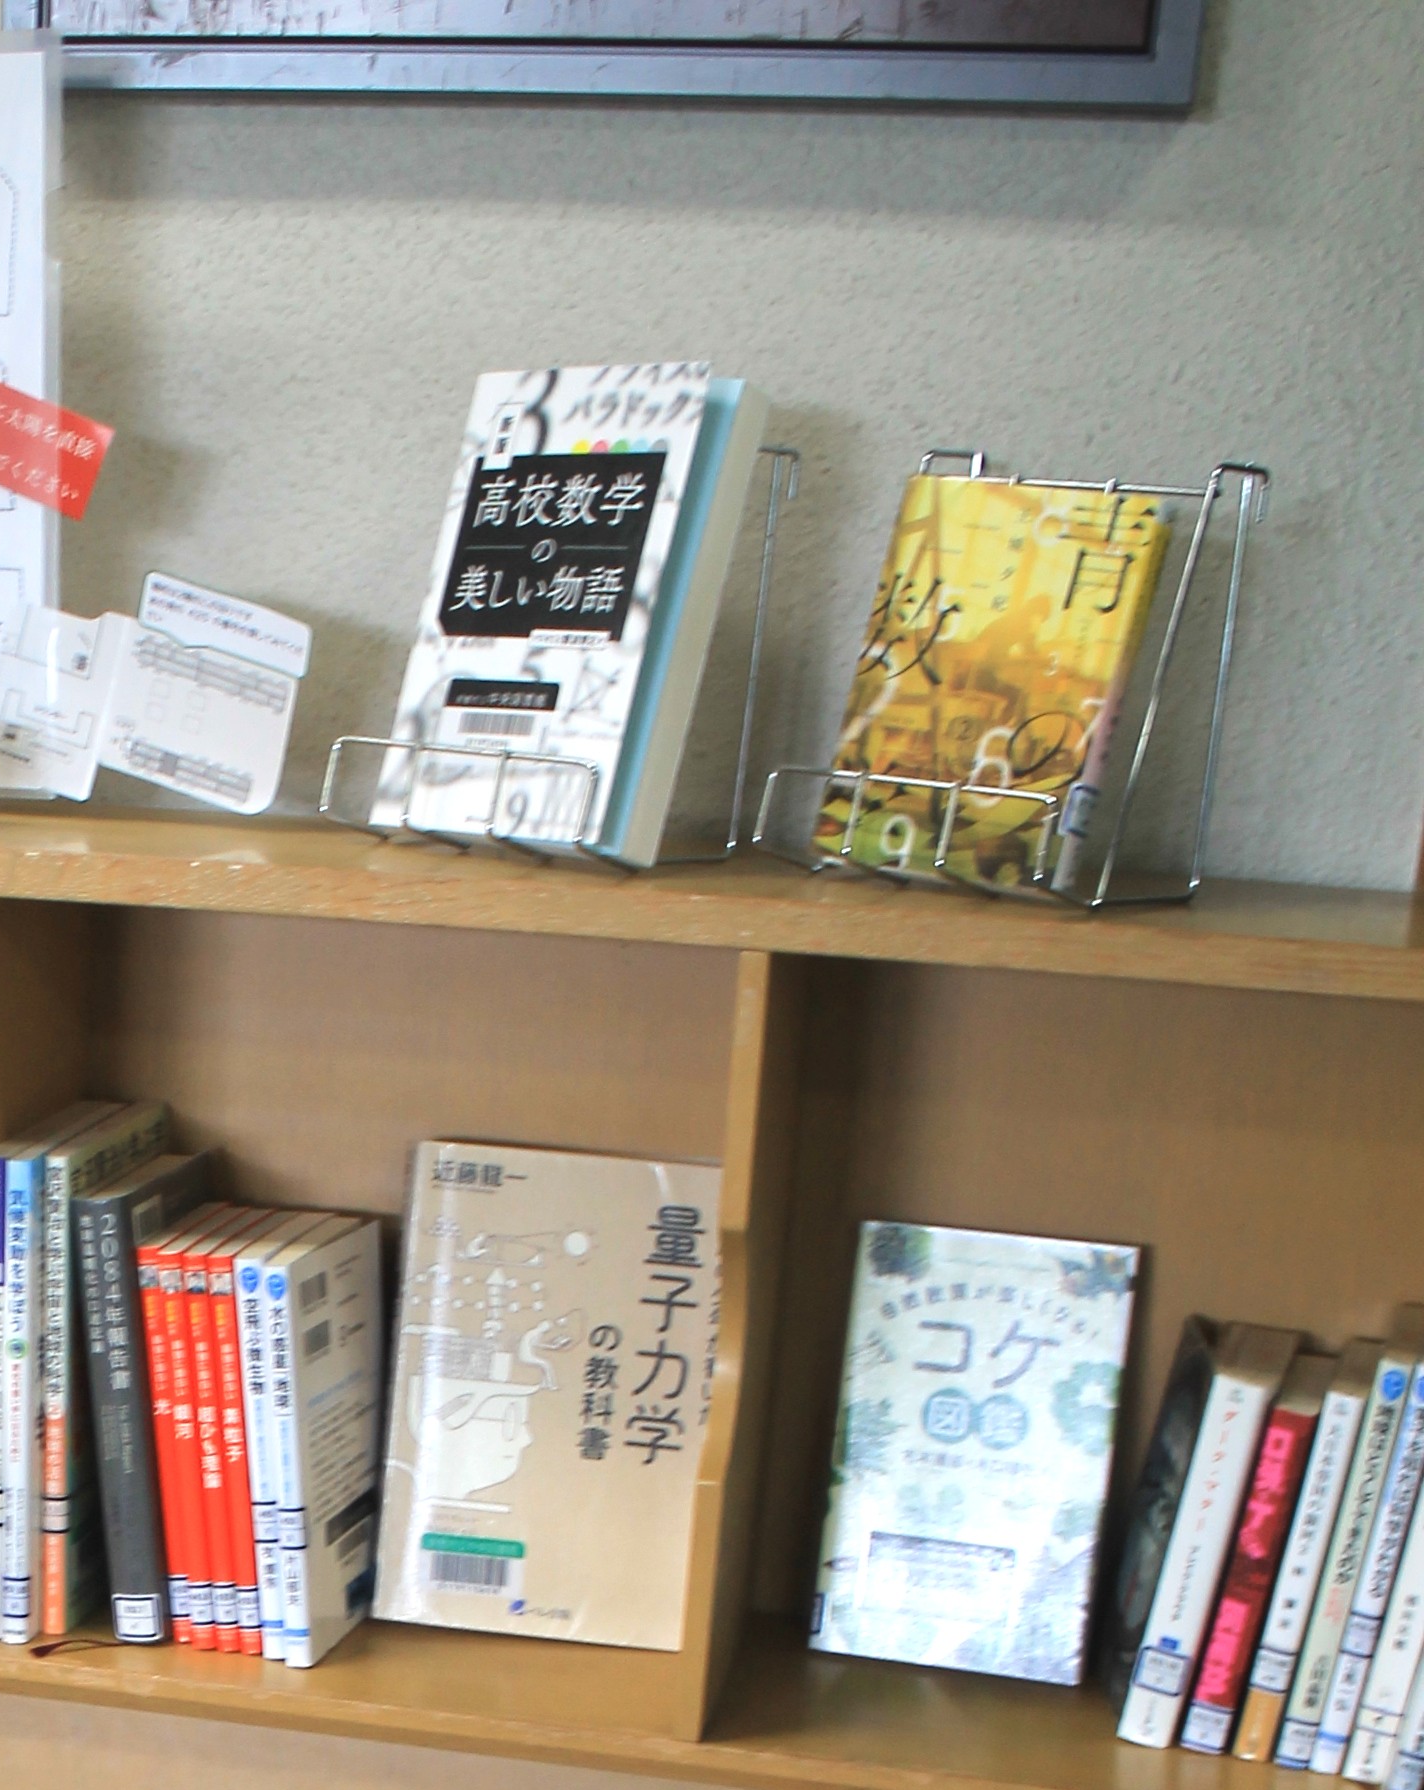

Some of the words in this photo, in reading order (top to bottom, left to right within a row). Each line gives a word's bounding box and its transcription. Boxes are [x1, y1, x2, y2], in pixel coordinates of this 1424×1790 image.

[473, 473, 648, 528] 高校数学
[531, 538, 558, 563] の
[449, 566, 625, 614] 美しい物語
[100, 1214, 132, 1390] 2084年報告書
[624, 1204, 707, 1466] 量子力学
[913, 1320, 1061, 1388] コケ
[578, 1325, 623, 1461] の教科書
[927, 1395, 1027, 1447] 図鑑
